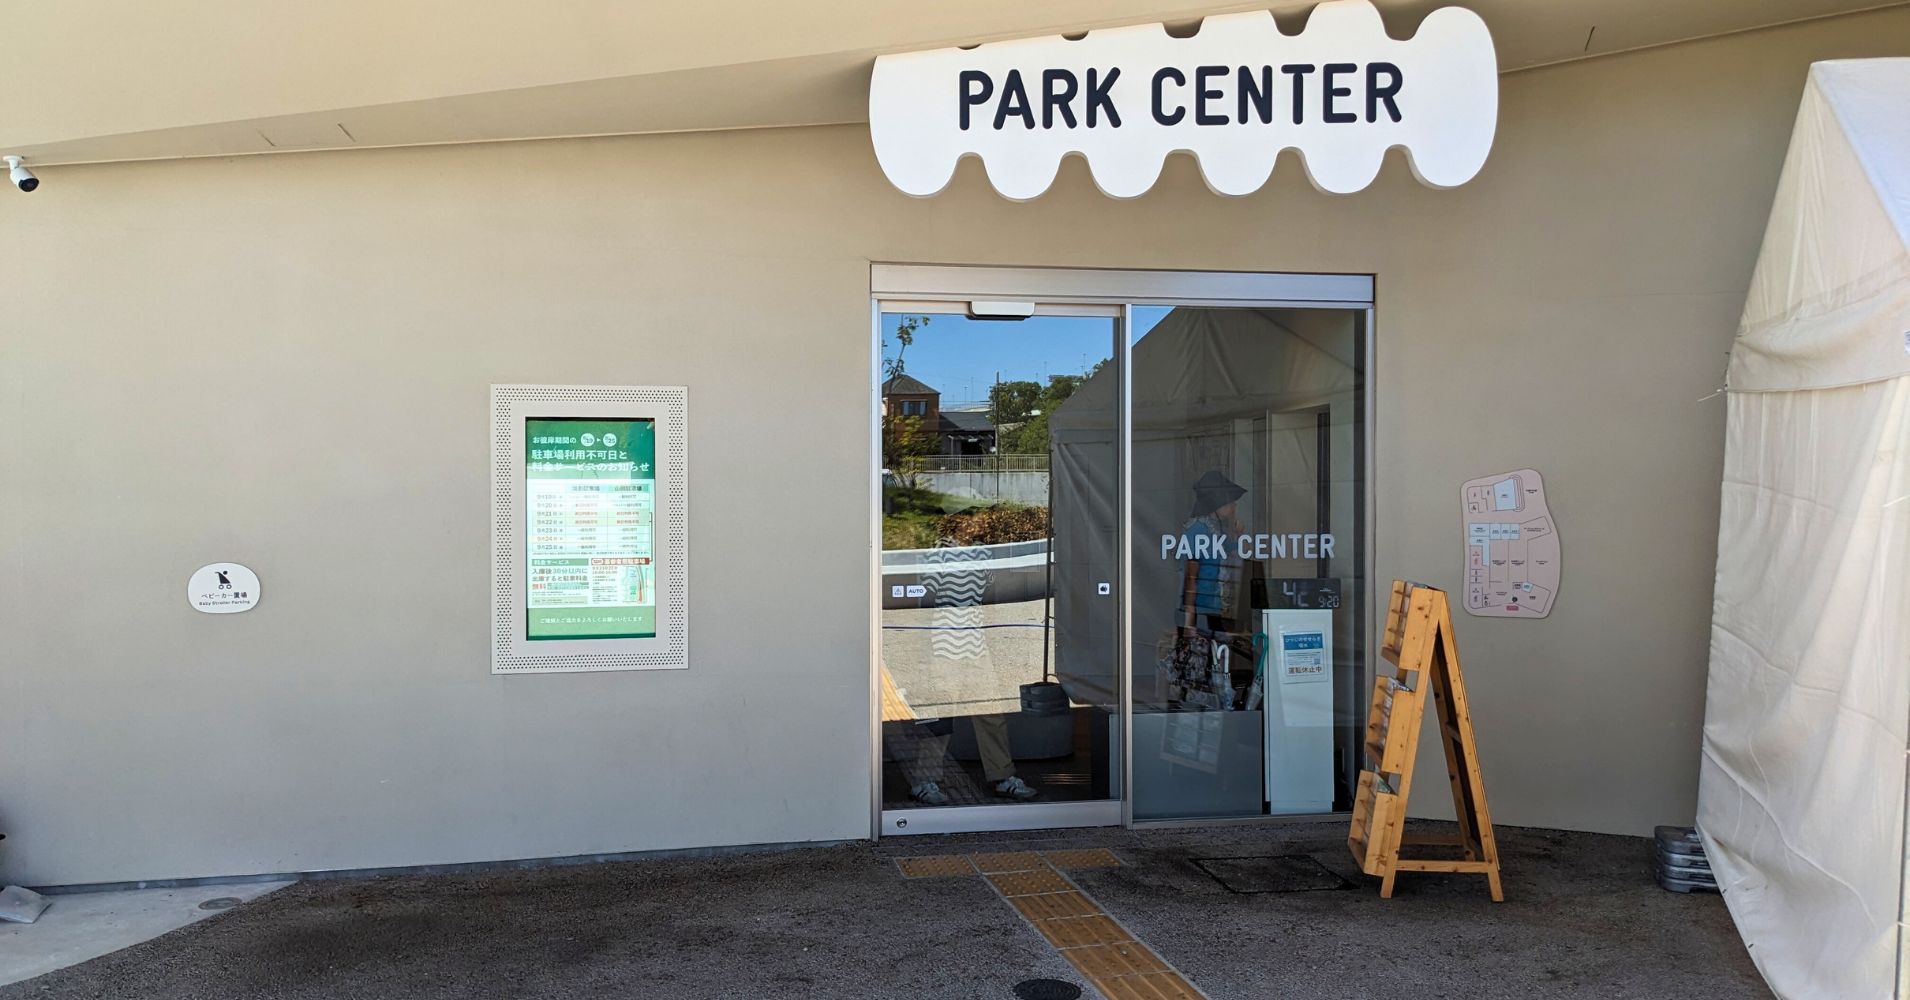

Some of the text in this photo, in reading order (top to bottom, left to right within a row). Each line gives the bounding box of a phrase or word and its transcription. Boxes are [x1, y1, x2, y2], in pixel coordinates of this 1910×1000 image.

[958, 62, 1404, 131] PARK CENTER
[531, 449, 628, 460] 駐車場利用不可日と
[531, 461, 650, 472] 料金サービスのお知らせ
[1161, 533, 1335, 560] PARK CENTER
[201, 591, 248, 599] ベビーカー置場
